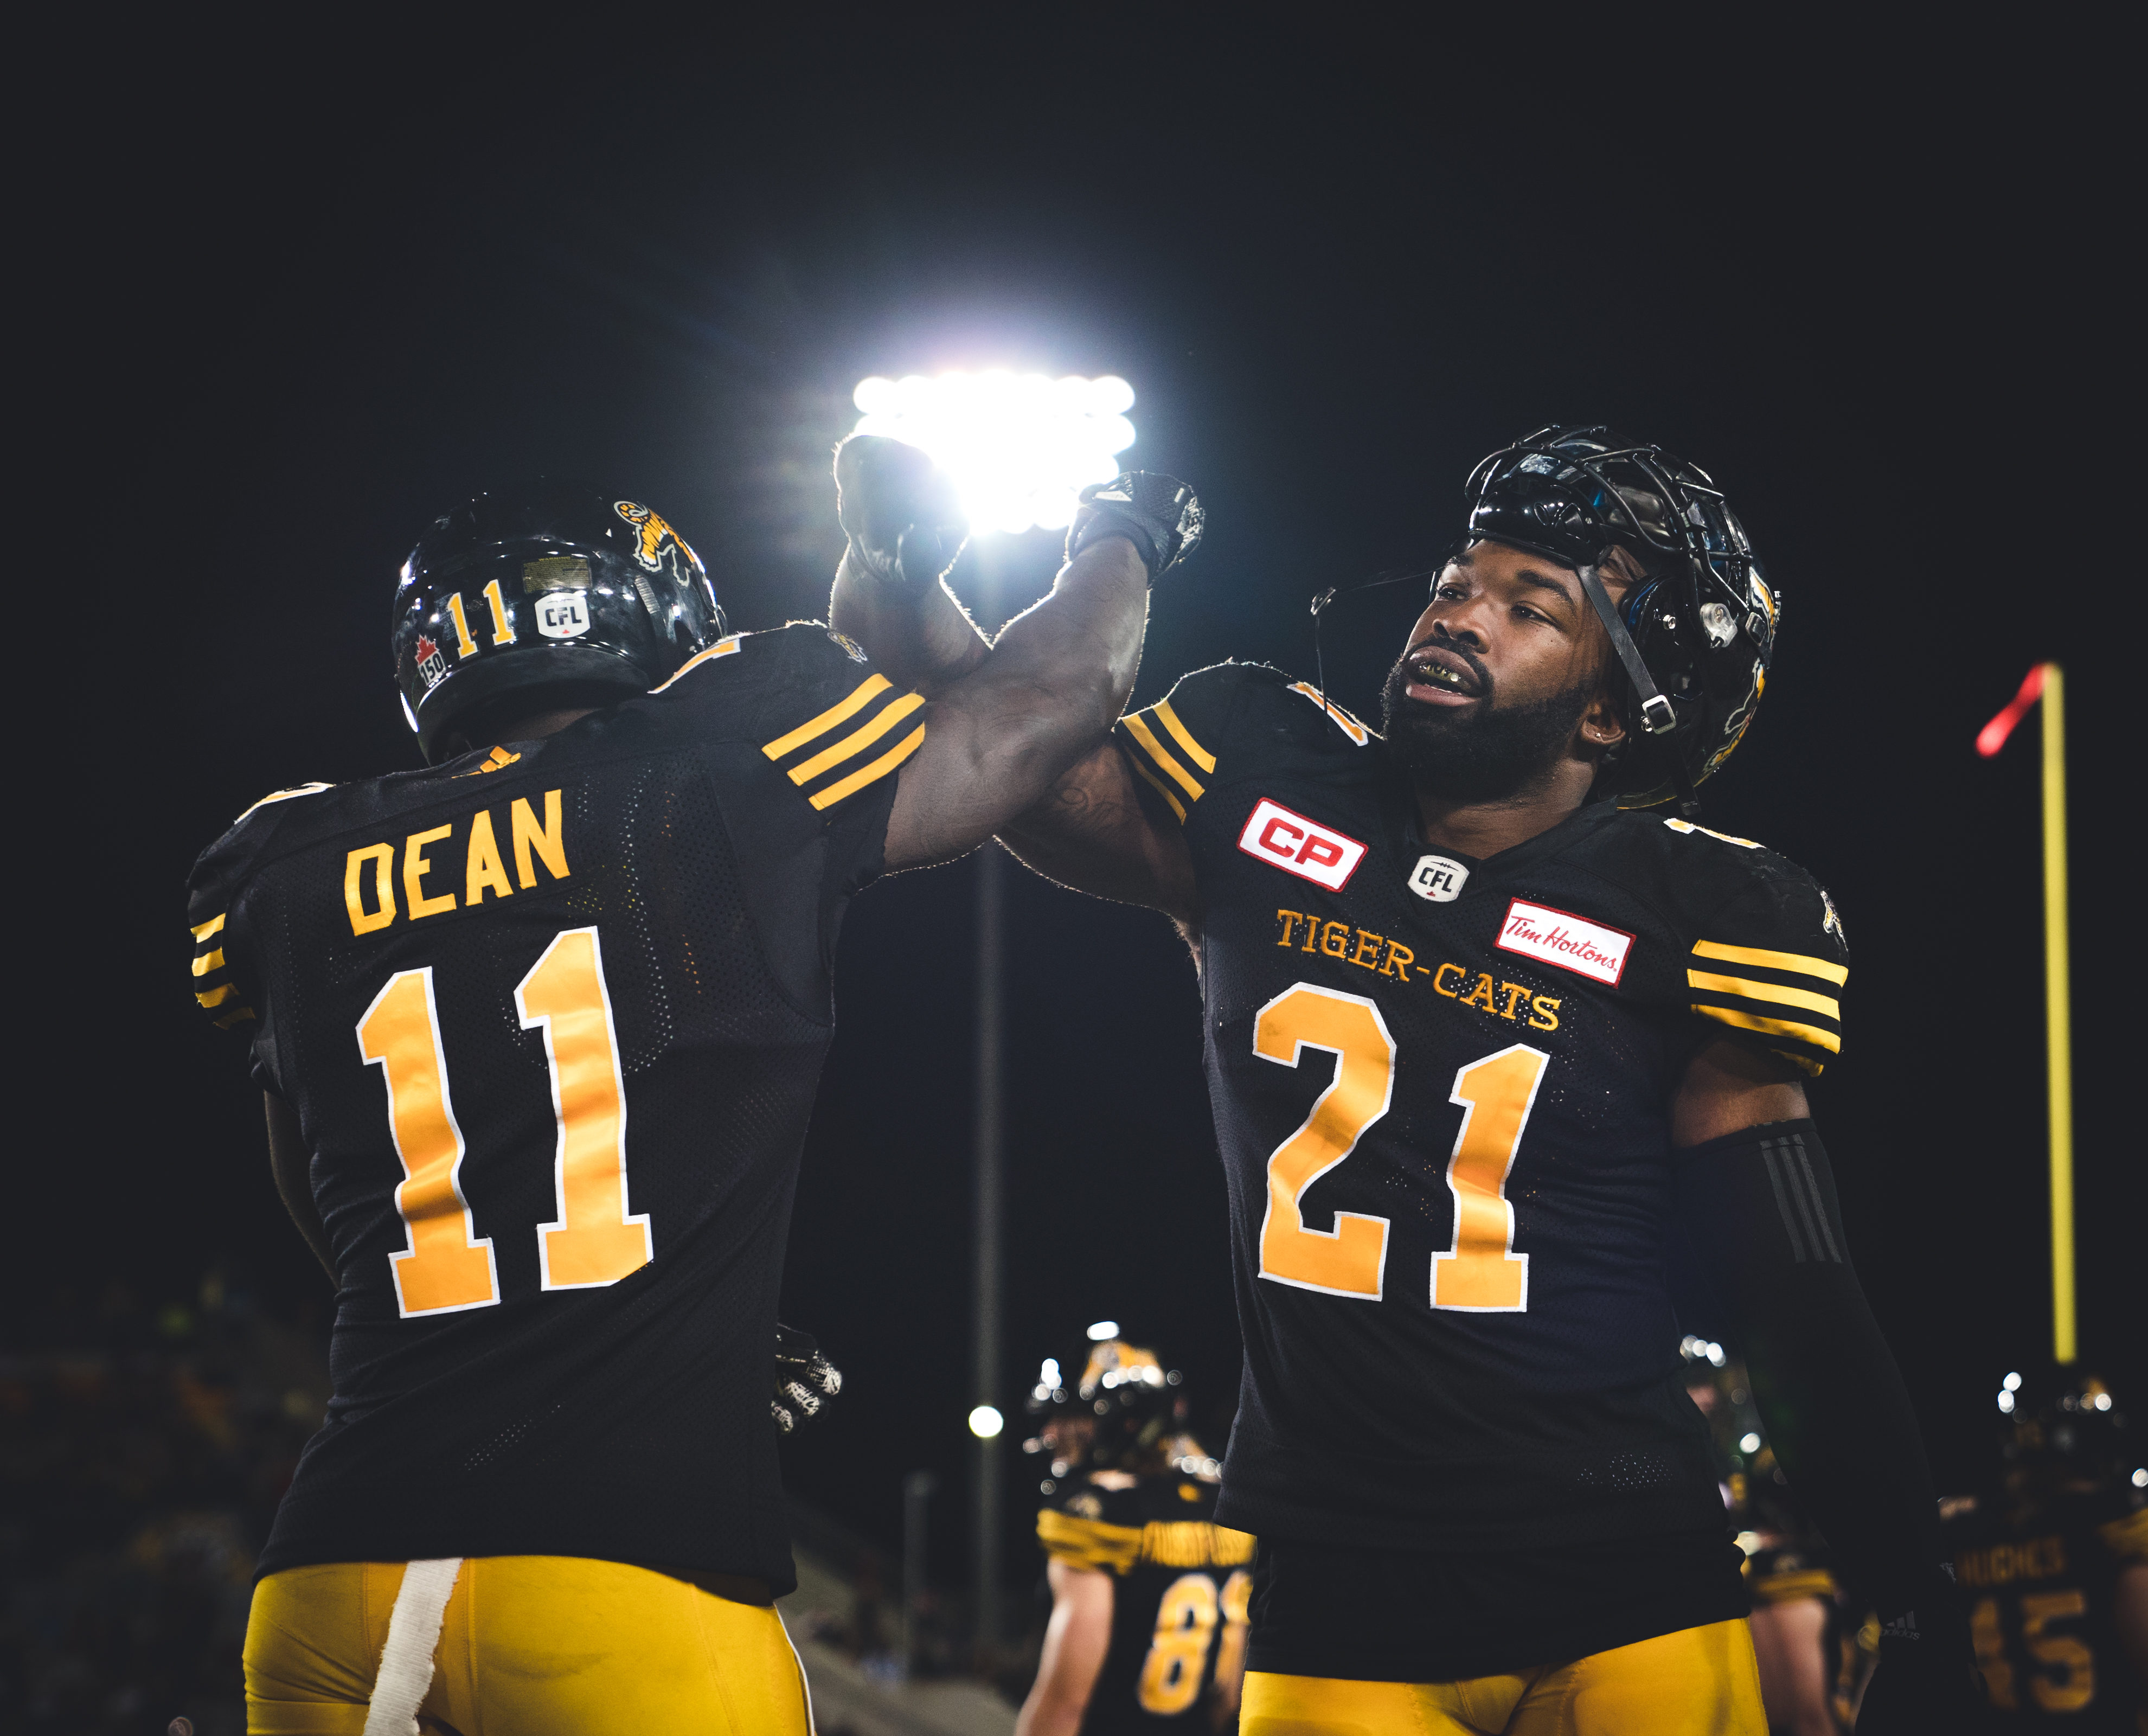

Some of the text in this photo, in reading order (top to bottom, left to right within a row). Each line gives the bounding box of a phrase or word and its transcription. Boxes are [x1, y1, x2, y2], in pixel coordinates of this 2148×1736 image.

[447, 579, 516, 660] 11
[545, 606, 582, 627] CFL
[420, 652, 444, 685] 150
[343, 789, 571, 937] DEAN
[1258, 817, 1344, 867] CP
[1418, 867, 1454, 893] CFL
[1505, 915, 1542, 943] Tim
[1277, 909, 1561, 1031] TIGER-CATS
[355, 925, 654, 1319] 11
[1252, 981, 1551, 1313] 21
[1880, 1628, 1920, 1641] adidas
[1971, 1589, 2094, 1713] 15
